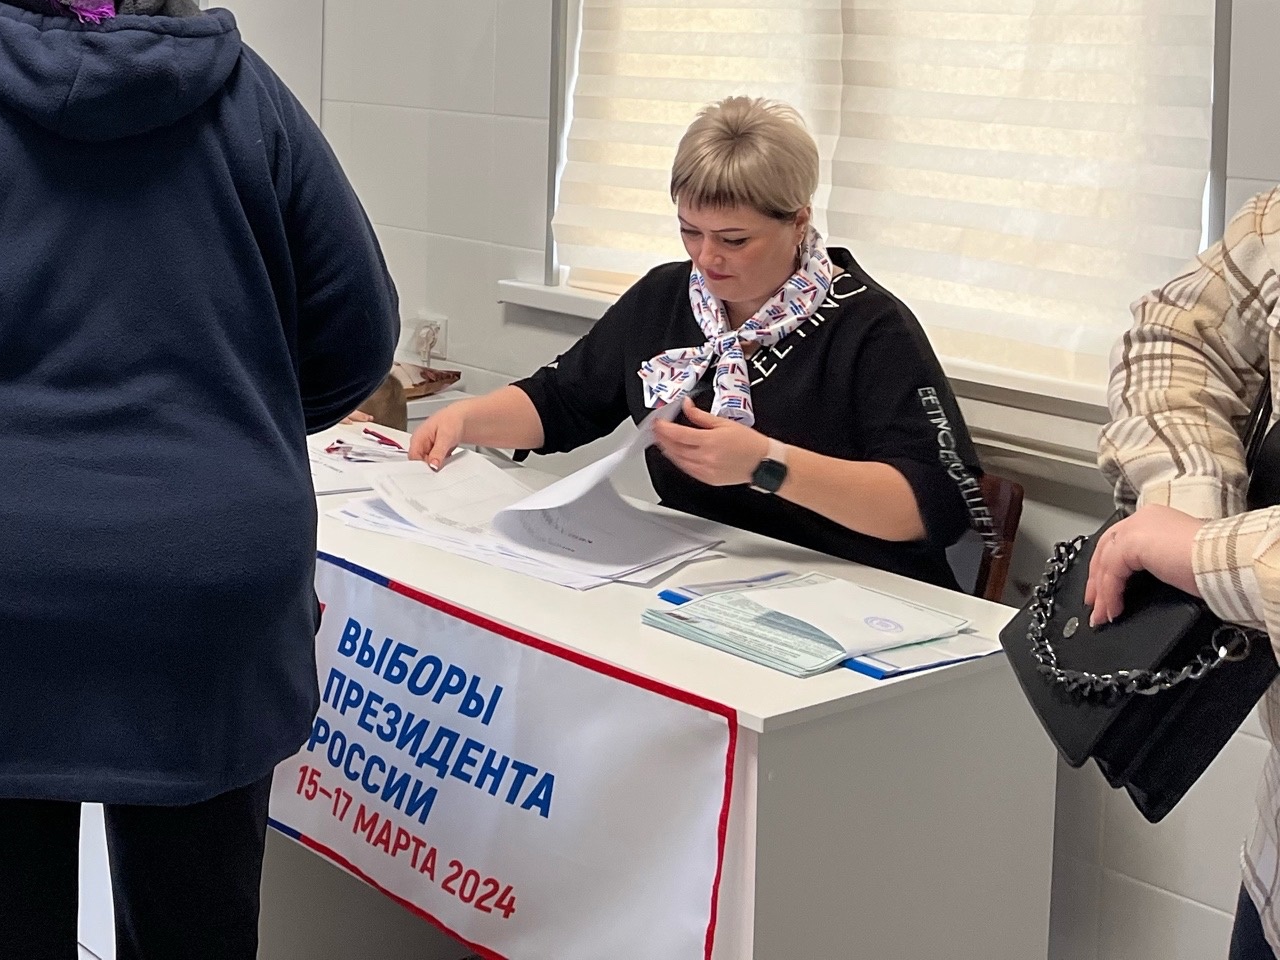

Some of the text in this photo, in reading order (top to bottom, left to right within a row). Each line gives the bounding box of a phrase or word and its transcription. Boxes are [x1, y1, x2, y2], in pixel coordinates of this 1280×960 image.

[336, 617, 503, 725] ВЫБОРЫ
[307, 715, 438, 825] РОССИИ
[322, 667, 557, 819] ПРЕЗИДЕНТА
[353, 802, 438, 881] МАРТА
[441, 859, 516, 919] 2024
